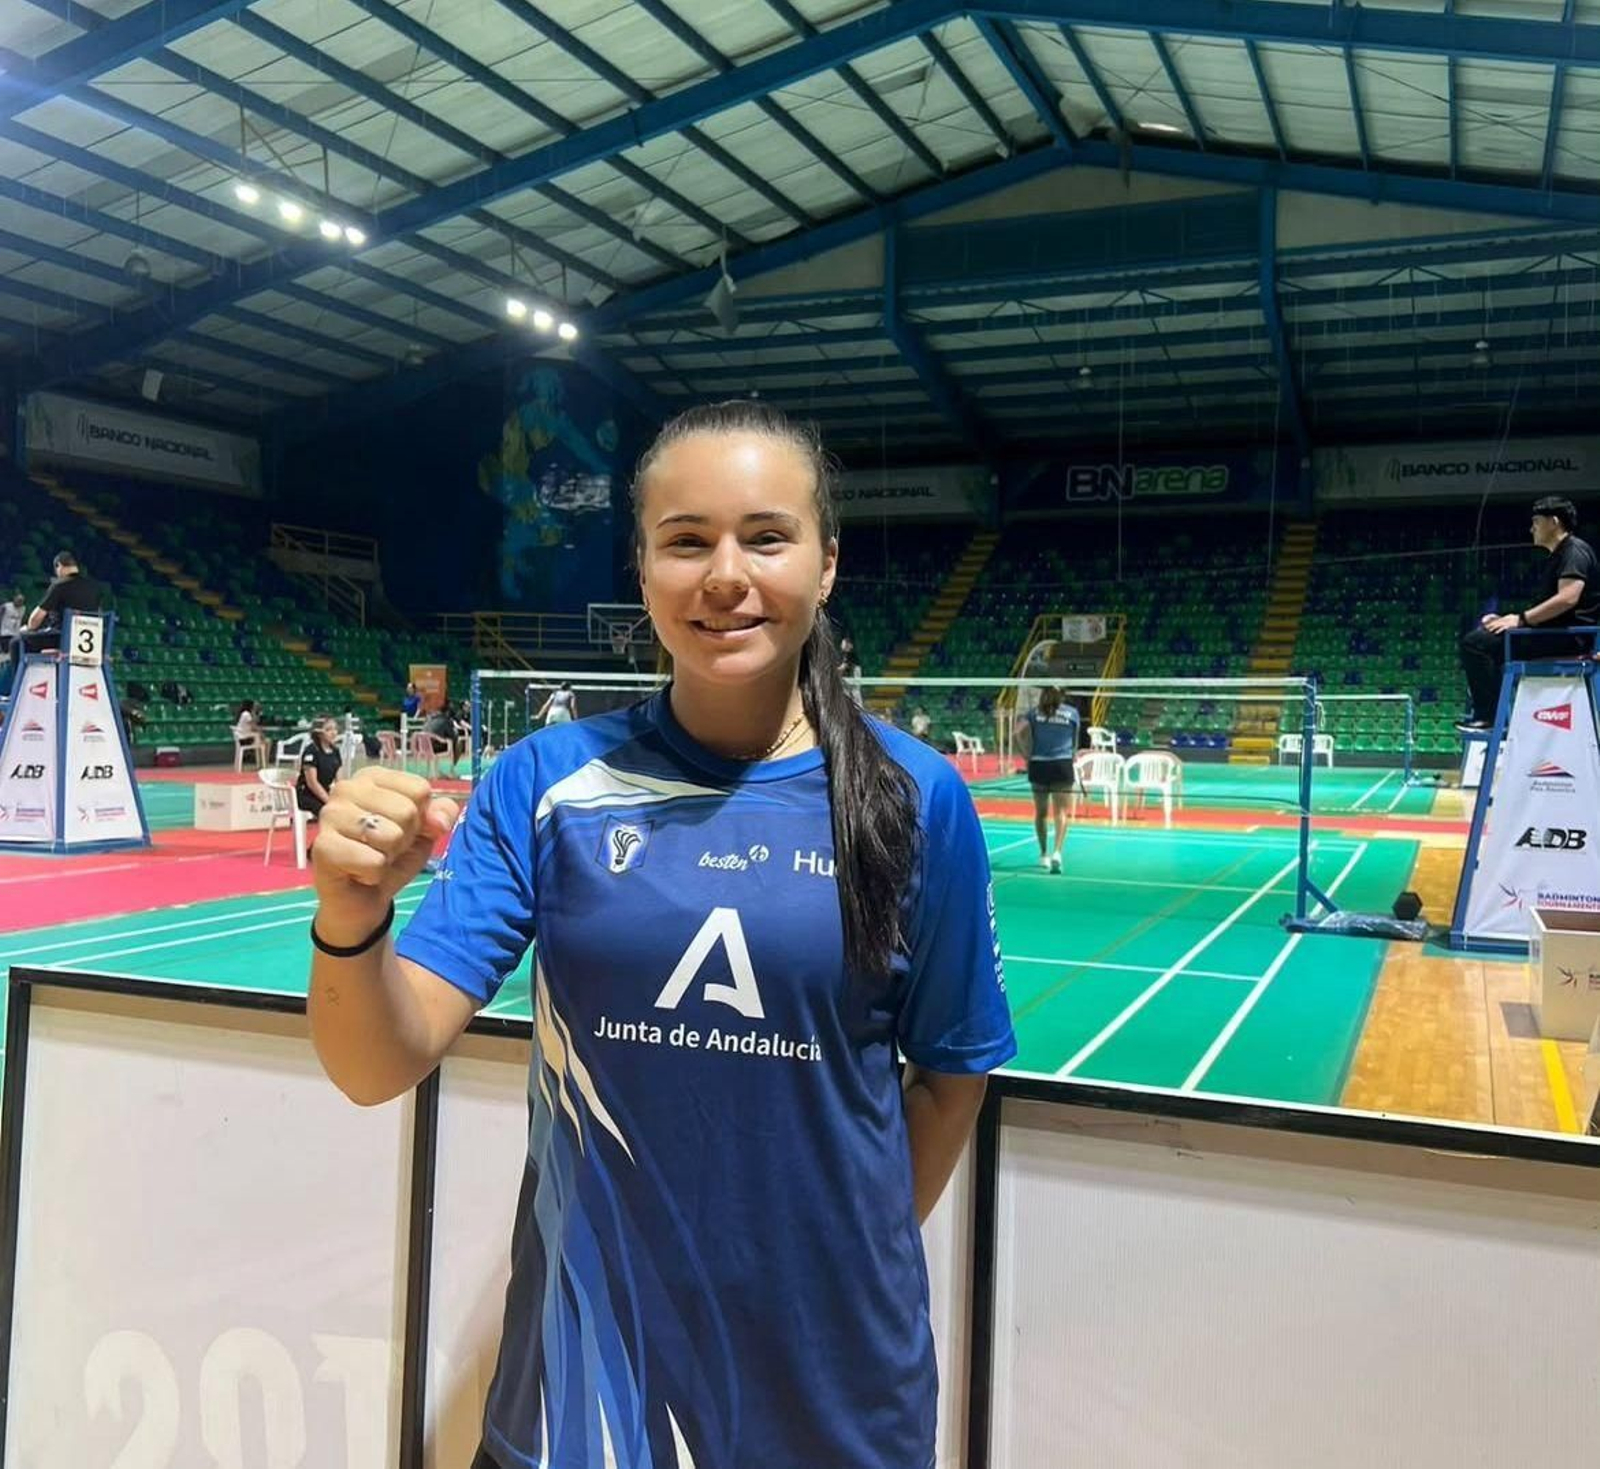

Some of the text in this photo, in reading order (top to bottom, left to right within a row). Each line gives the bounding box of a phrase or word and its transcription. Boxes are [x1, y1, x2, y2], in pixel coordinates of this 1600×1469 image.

[89, 424, 141, 447] BANCO
[1402, 458, 1579, 478] BANCO NACIONAL
[1066, 464, 1229, 501] BNarena
[78, 629, 94, 654] 3
[1514, 827, 1588, 850] ADB
[698, 851, 750, 872] besten
[793, 849, 838, 877] Hu
[593, 1016, 823, 1062] Junta de Andalucía
